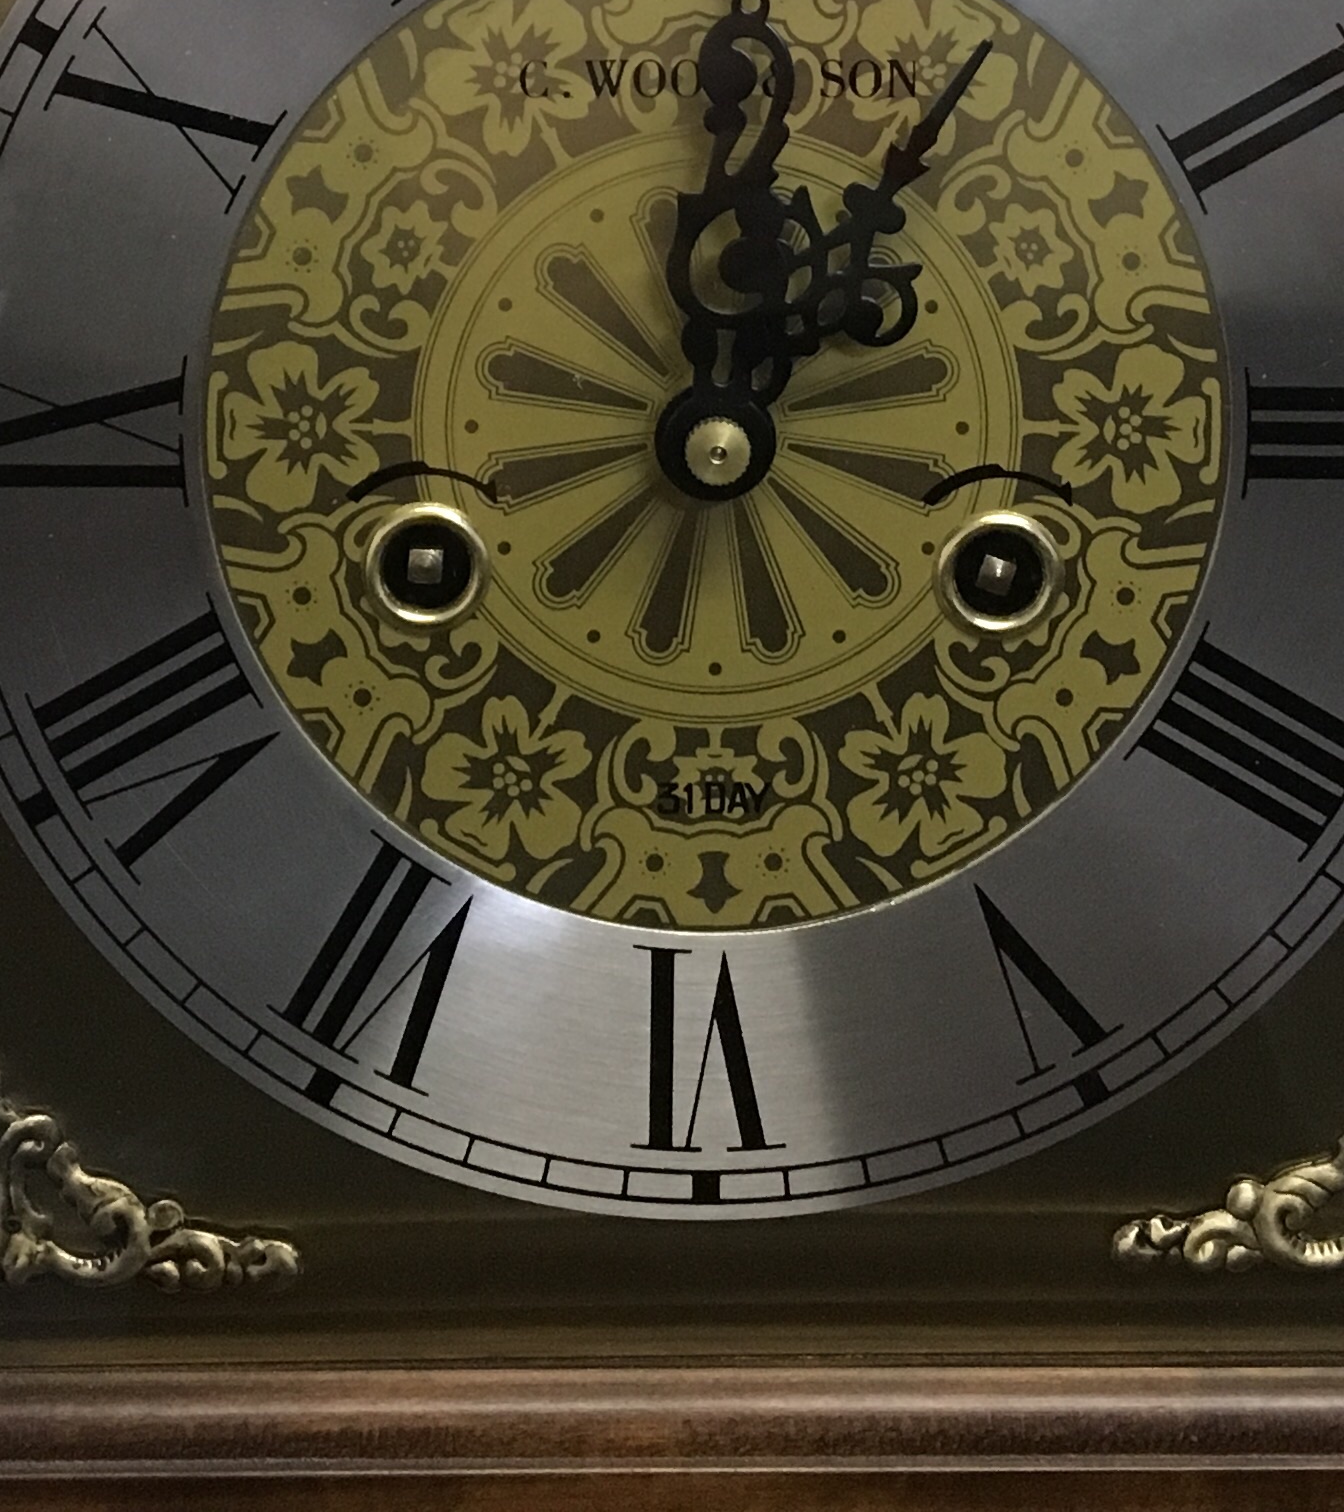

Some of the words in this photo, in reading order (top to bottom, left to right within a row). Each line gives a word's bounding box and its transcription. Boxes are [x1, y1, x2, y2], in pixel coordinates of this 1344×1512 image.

[585, 59, 701, 99] WOO
[820, 59, 917, 99] SON
[43, 6, 288, 214] X
[657, 782, 694, 815] 31
[705, 782, 772, 815] DAY
